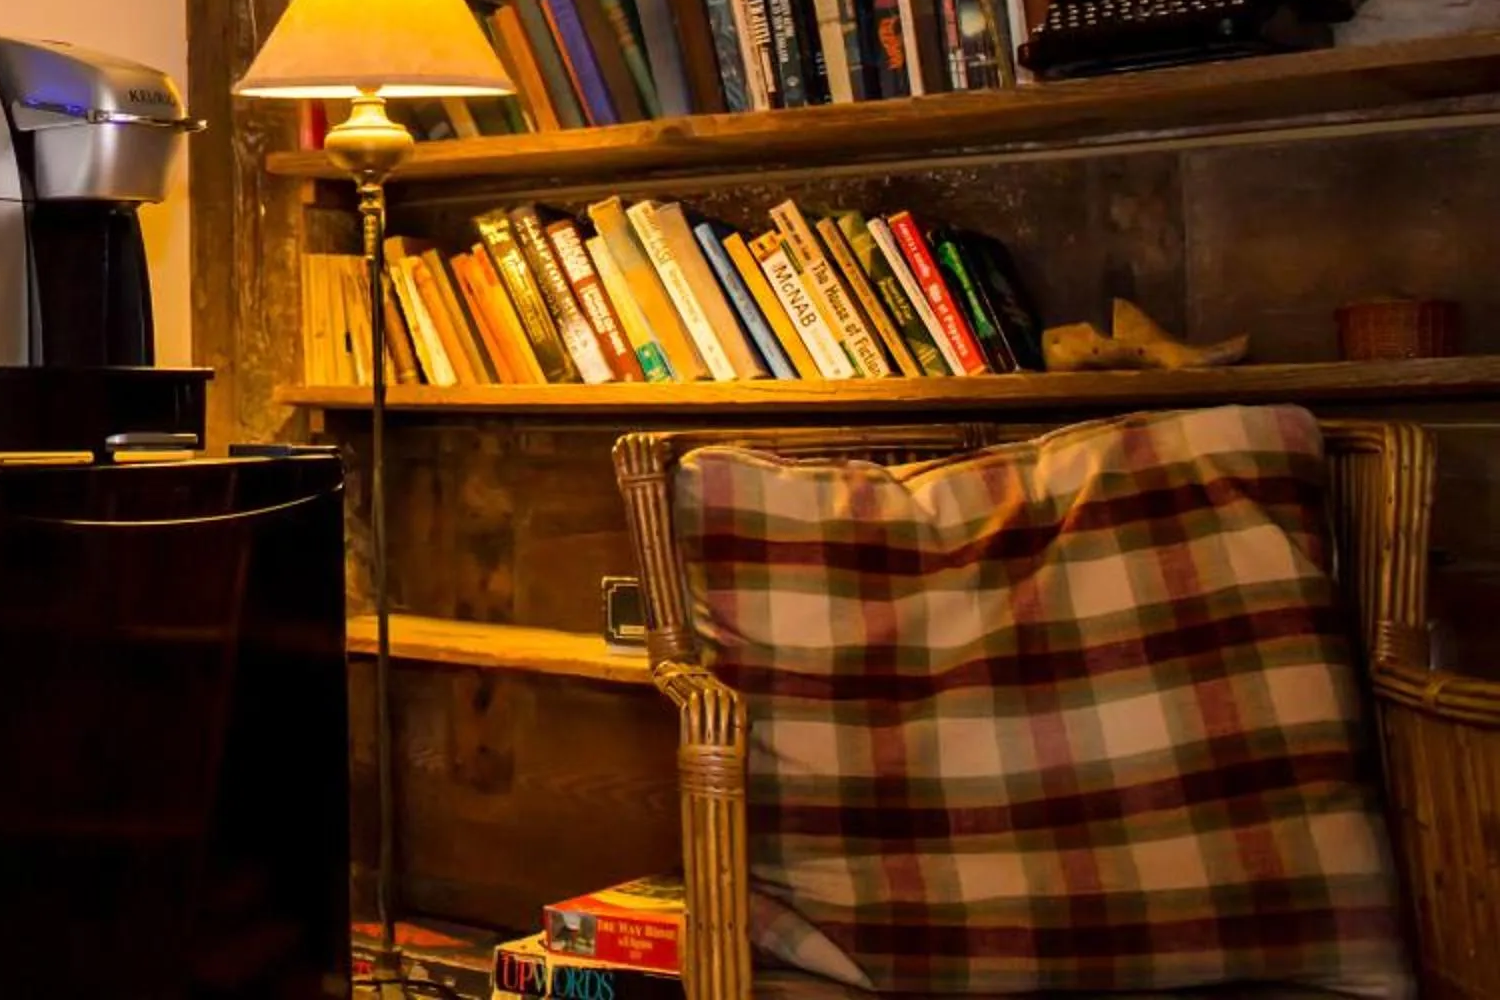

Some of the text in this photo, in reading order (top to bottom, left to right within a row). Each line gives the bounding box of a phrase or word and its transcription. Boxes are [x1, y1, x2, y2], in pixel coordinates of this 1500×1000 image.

[773, 263, 817, 327] McNAB
[812, 257, 829, 285] The
[823, 281, 847, 322] House
[844, 321, 862, 337] of
[853, 336, 882, 376] Fiction
[619, 920, 643, 937] WAY
